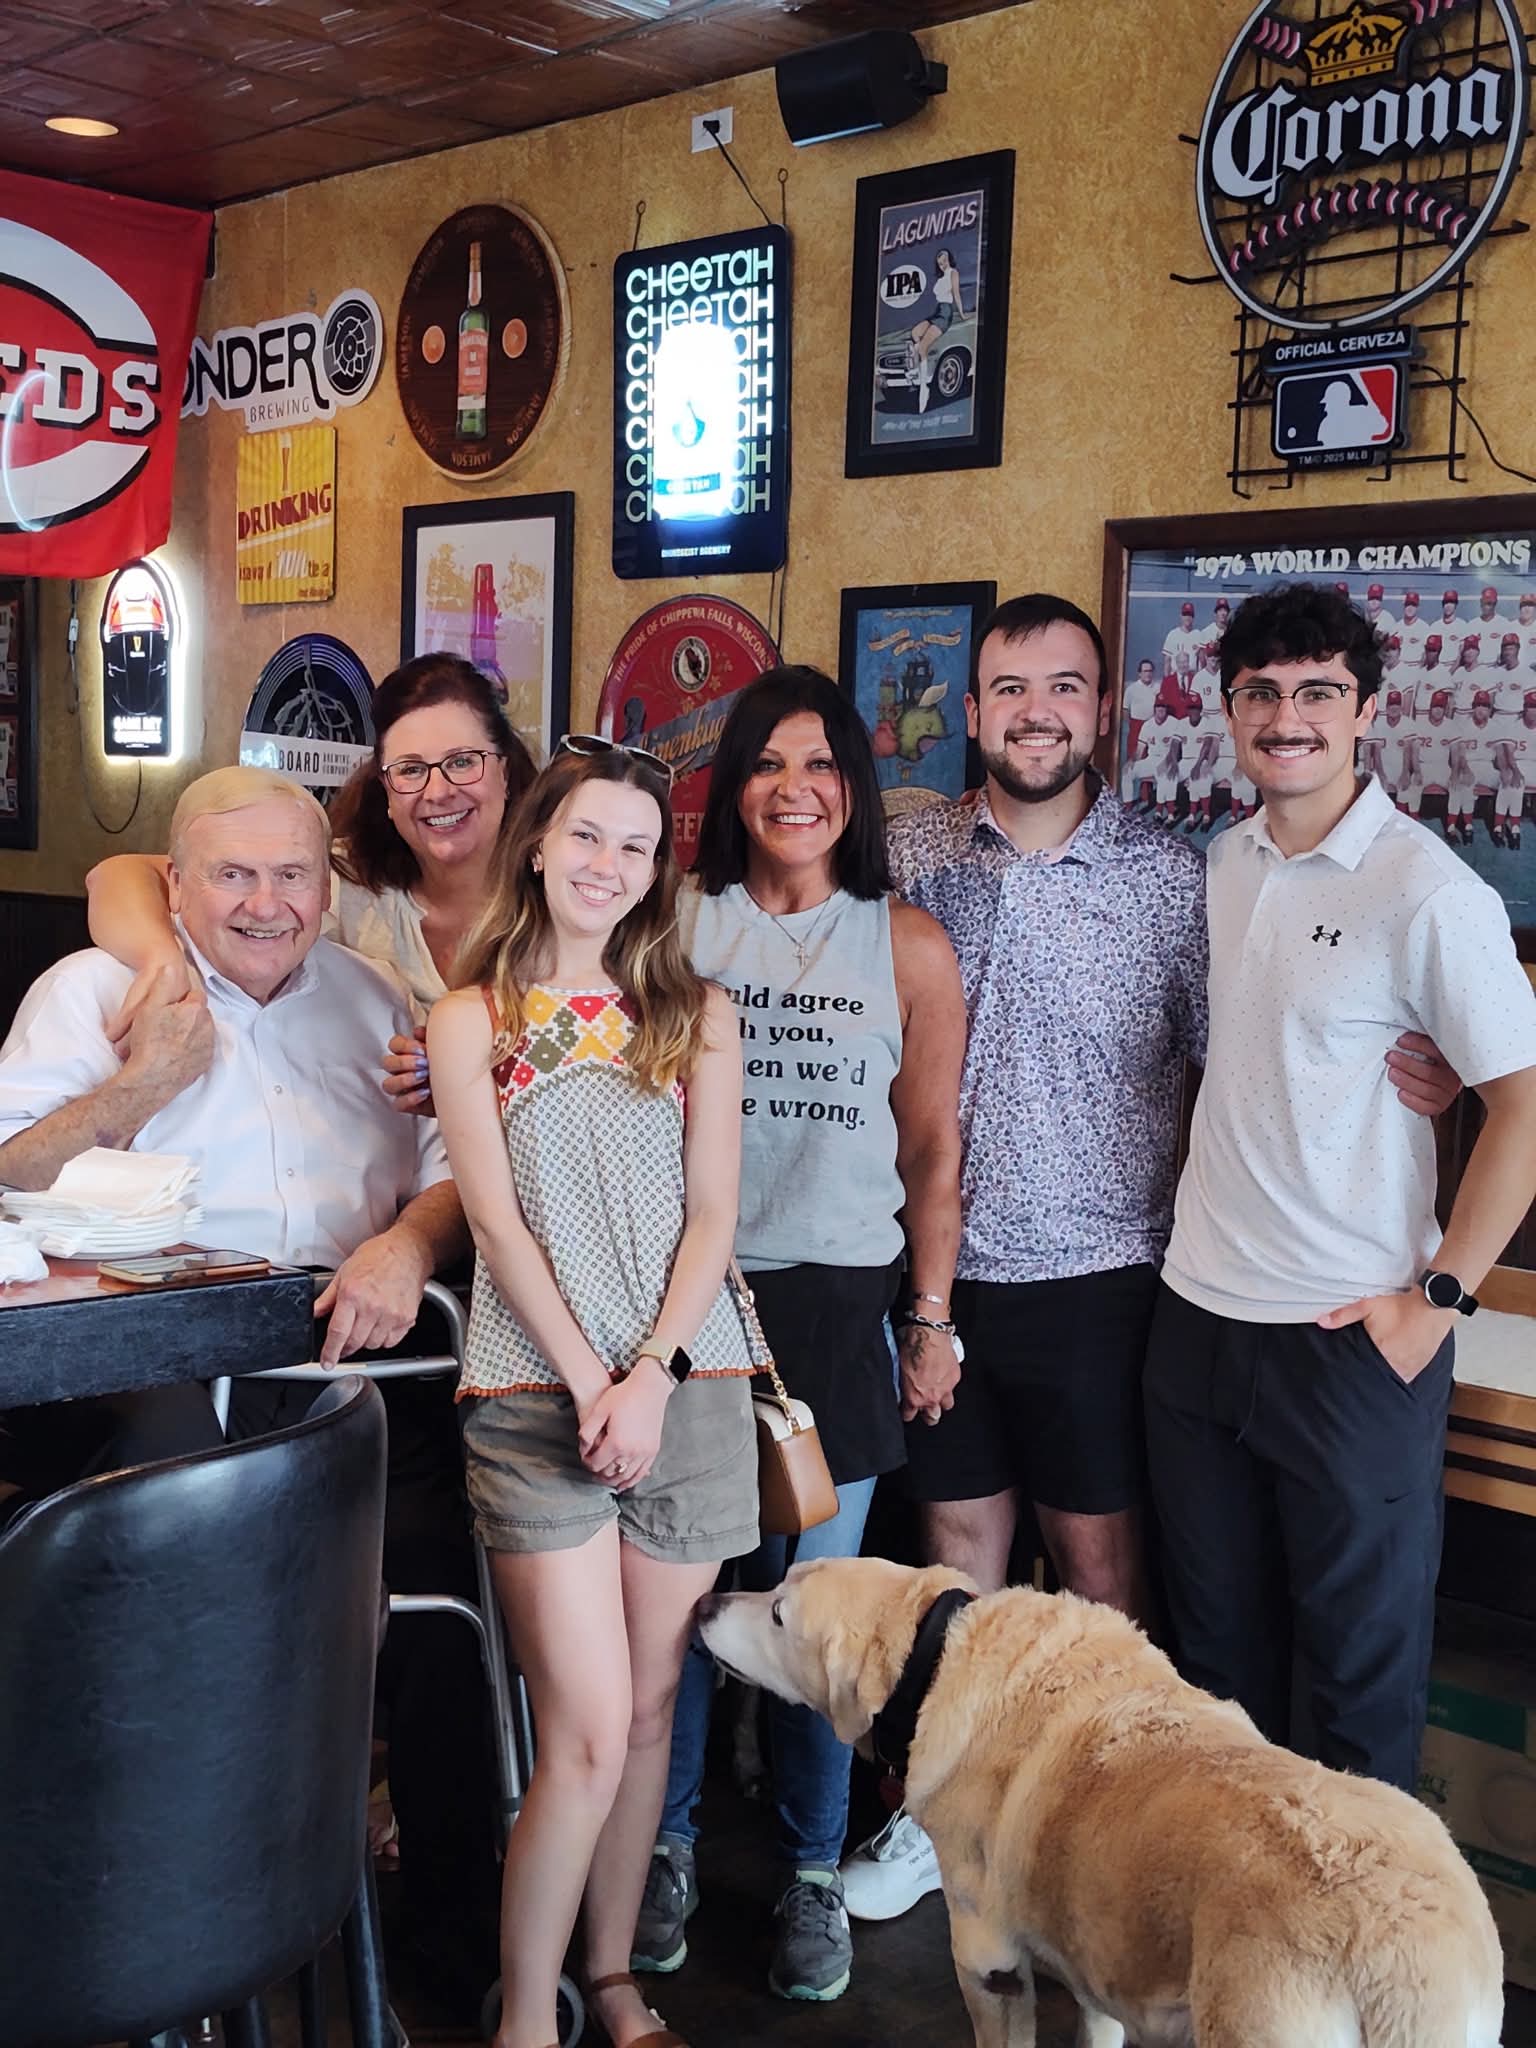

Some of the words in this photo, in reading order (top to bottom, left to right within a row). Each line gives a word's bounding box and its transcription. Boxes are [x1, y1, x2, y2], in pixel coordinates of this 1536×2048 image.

[1212, 67, 1502, 205] Corona
[882, 200, 978, 250] LAGUNITAS
[886, 270, 922, 299] IPA
[1275, 340, 1335, 361] OFFICIAL
[1339, 330, 1406, 353] CERVEZA
[182, 323, 329, 410] NDER
[250, 396, 310, 423] BREWING
[1347, 449, 1368, 460] MLB
[238, 483, 331, 540] DRINKING
[1250, 548, 1350, 576] WORLD
[1357, 540, 1530, 571] CHAMPIONS
[613, 661, 629, 682] THE
[624, 631, 648, 661] PRIDE
[646, 622, 658, 636] OF
[659, 607, 705, 627] CHIPPEWA
[707, 608, 734, 631] FALLS,
[781, 991, 864, 1016] agree
[768, 1026, 834, 1047] you,
[743, 1058, 783, 1079] en
[796, 1056, 866, 1086] we'd
[741, 1097, 757, 1116] e
[769, 1098, 866, 1131] wrong.
